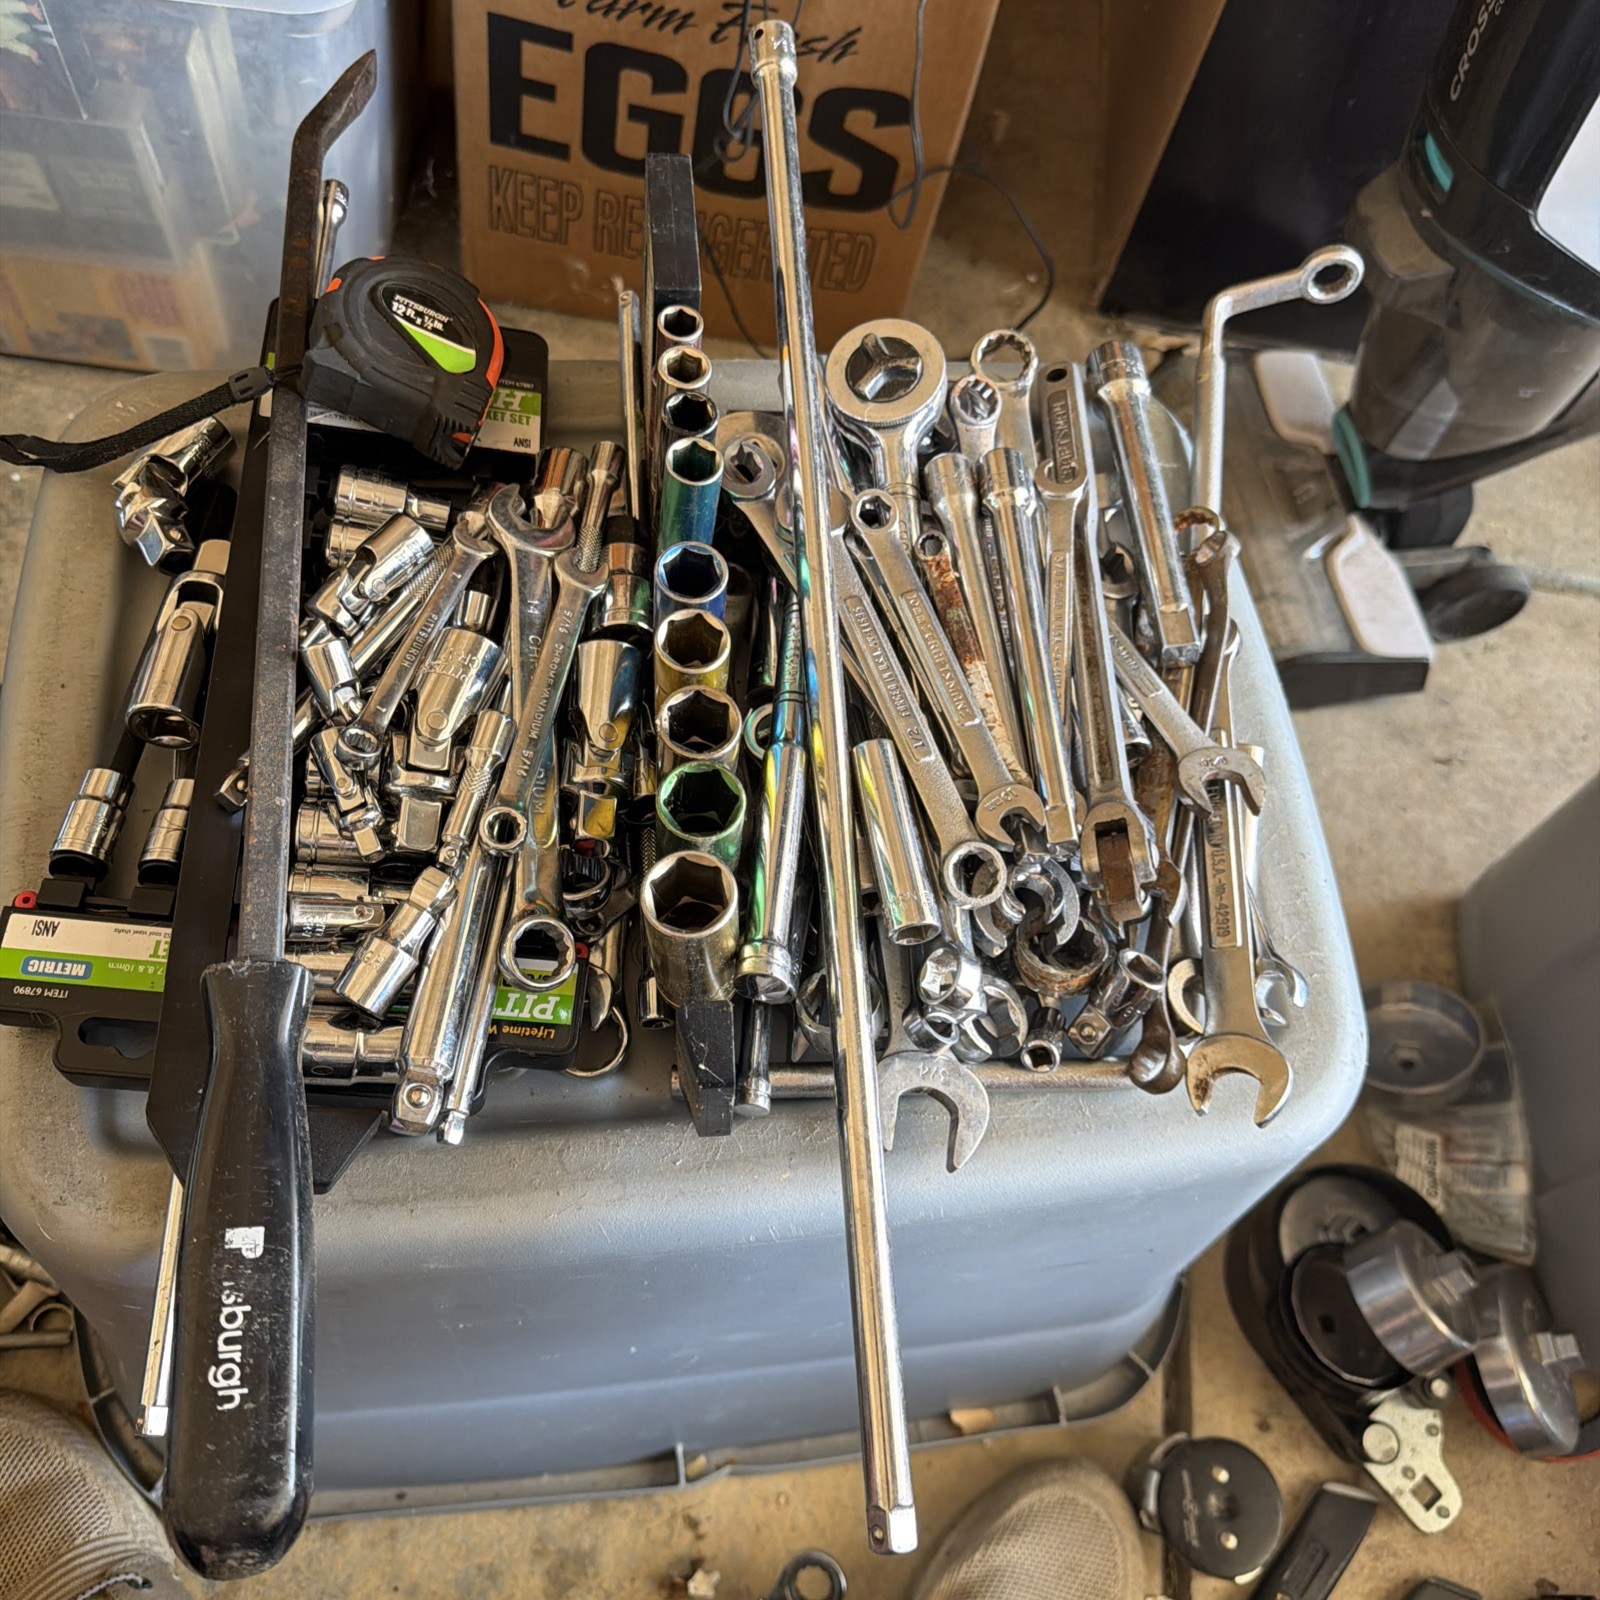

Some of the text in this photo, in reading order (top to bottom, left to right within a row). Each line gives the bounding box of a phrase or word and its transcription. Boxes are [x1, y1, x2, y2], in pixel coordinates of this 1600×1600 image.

[709, 1, 863, 65] Fsh
[488, 164, 584, 246] KEEP
[391, 301, 407, 317] 12
[394, 294, 450, 324] PITTSBURGH
[509, 412, 533, 426] SET
[513, 437, 532, 449] ANSI
[526, 599, 541, 615] 14
[401, 613, 439, 669] PITTSBURGH
[515, 609, 574, 778] 5/16 CHROME VANADIUM 5/16
[906, 724, 926, 750] 1/2
[31, 918, 61, 938] ANSI
[113, 927, 131, 935] shafts
[132, 928, 149, 936] steel
[27, 959, 87, 977] METRIC
[107, 962, 134, 974] 10mm
[13, 985, 69, 999] ITEM 67890
[502, 1025, 556, 1040] Lifetime
